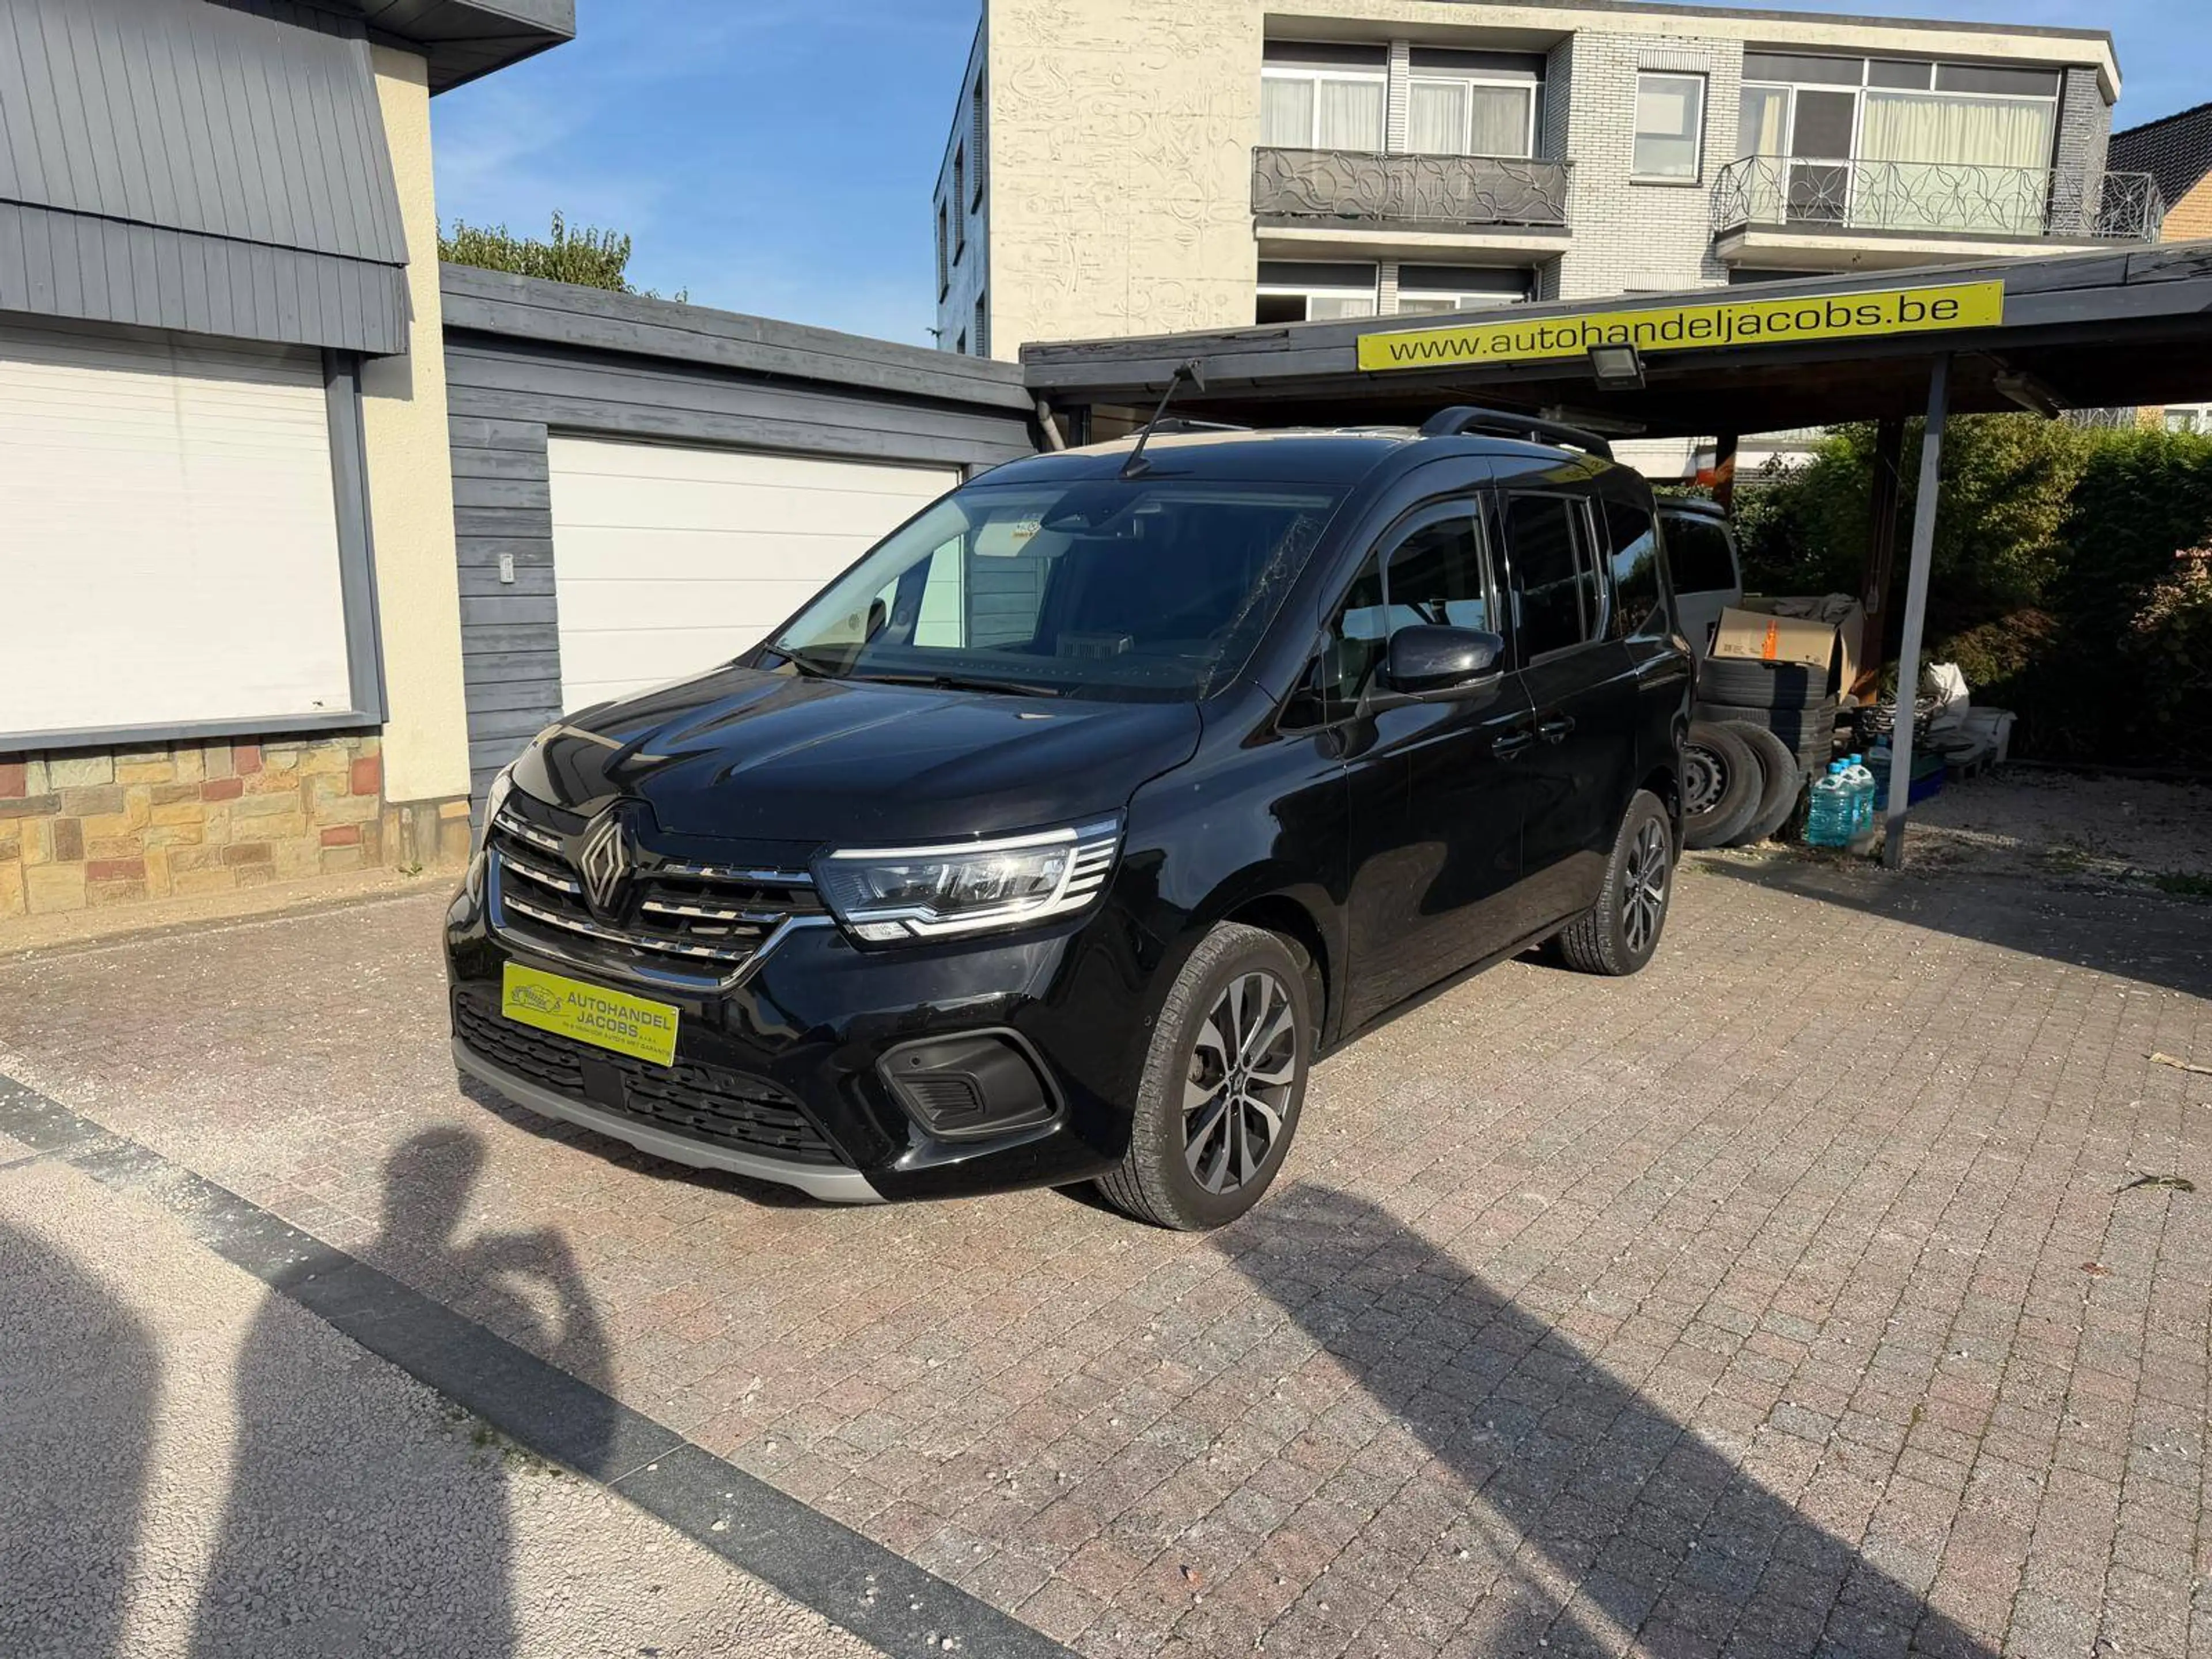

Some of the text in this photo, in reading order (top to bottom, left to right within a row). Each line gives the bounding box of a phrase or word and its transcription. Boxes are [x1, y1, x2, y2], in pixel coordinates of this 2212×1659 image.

[1389, 295, 1959, 361] www.autohandeljacobs.be
[567, 991, 671, 1031] AUTOHANDEL
[577, 1011, 638, 1037] JACOBS
